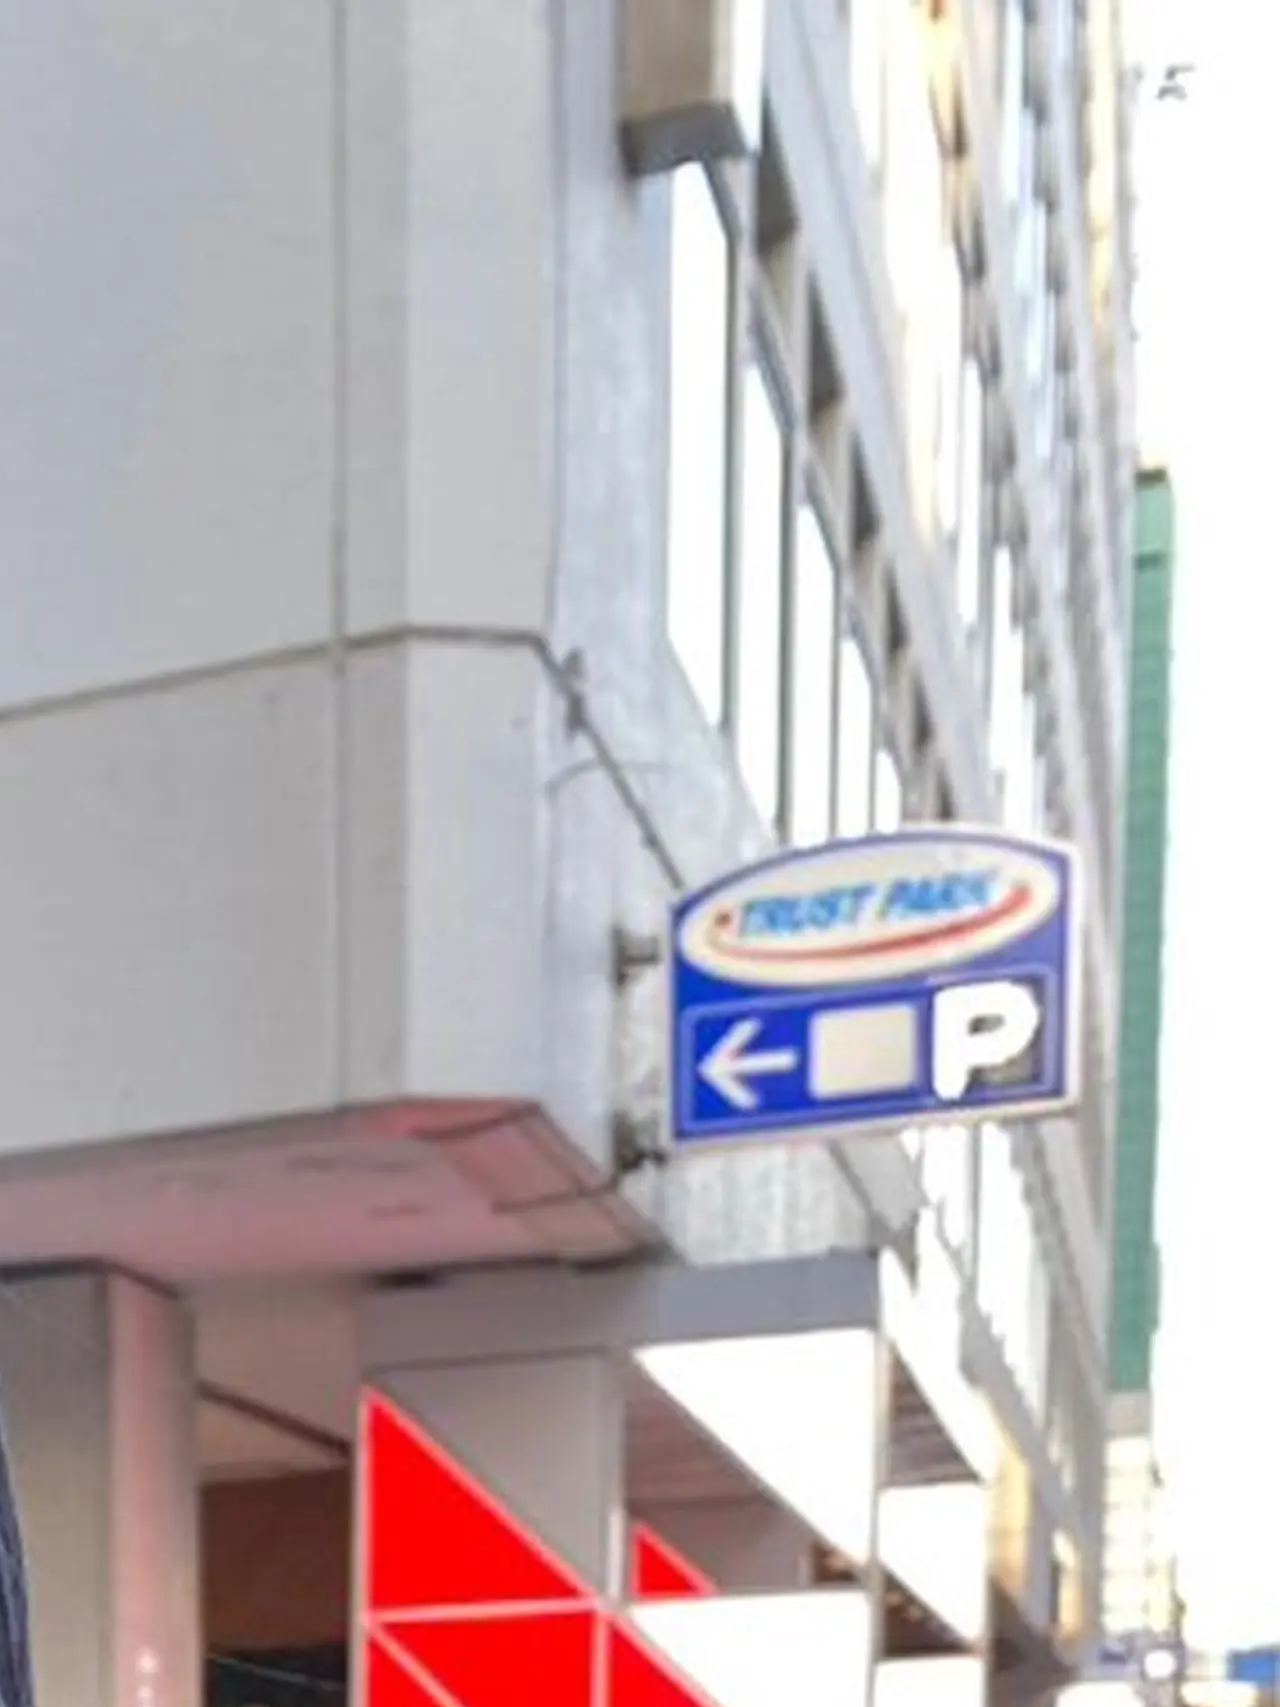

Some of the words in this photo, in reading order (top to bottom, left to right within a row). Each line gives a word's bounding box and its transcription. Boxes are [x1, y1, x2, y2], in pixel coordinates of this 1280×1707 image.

[742, 887, 874, 936] TRUST
[878, 868, 998, 914] PARK
[933, 980, 1039, 1100] P
